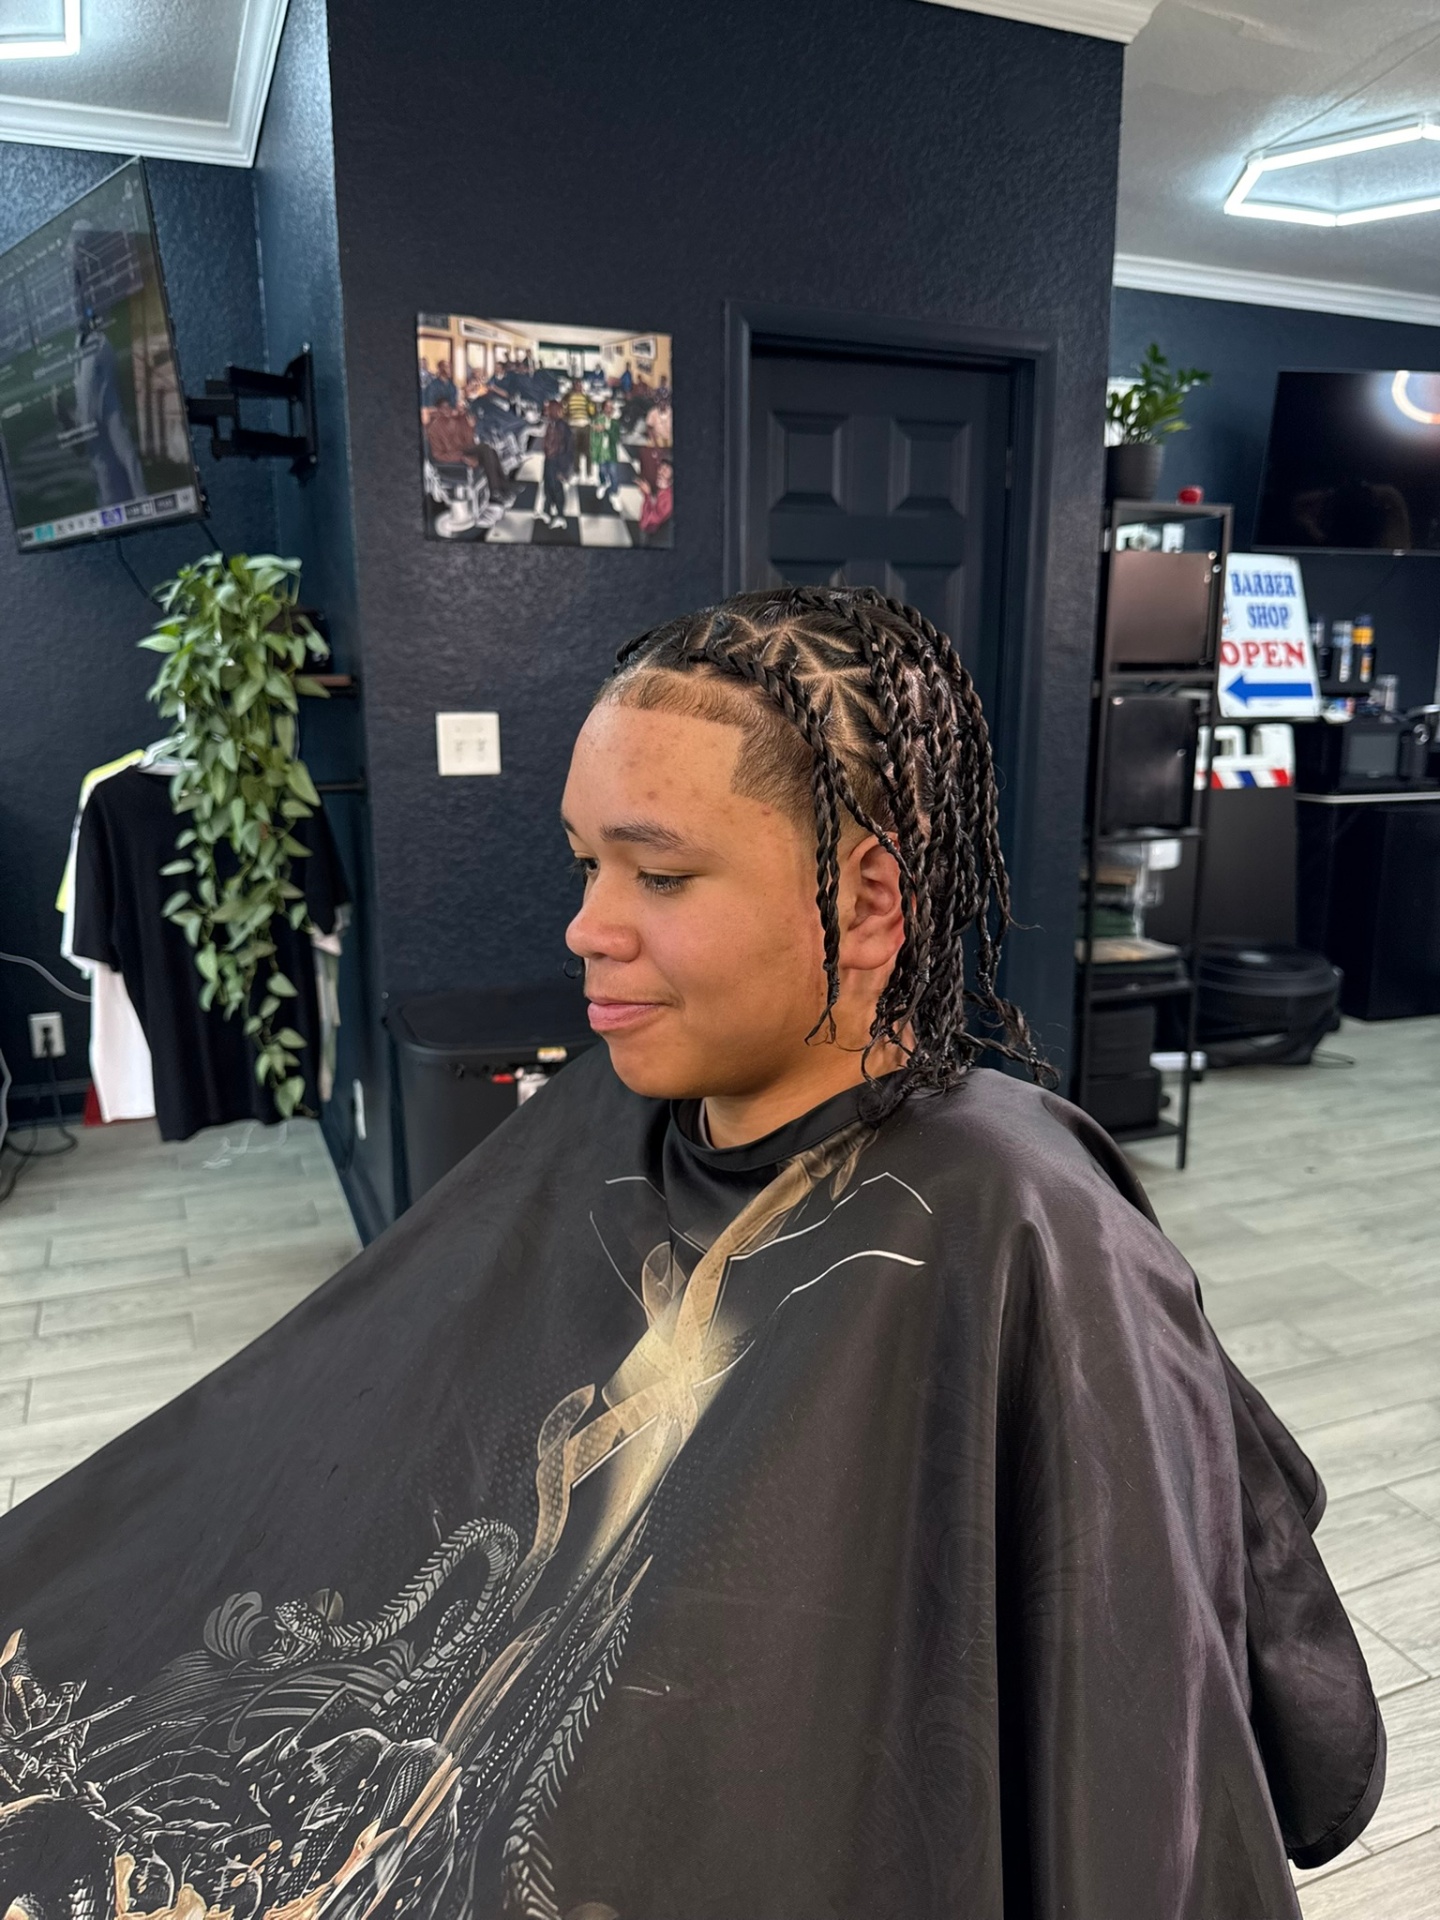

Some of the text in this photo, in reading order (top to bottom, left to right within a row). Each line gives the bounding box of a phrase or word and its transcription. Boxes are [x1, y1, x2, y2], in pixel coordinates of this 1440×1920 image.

[1230, 572, 1296, 597] BARBER
[1247, 604, 1290, 628] SHOP
[1220, 640, 1305, 667] OPEN
